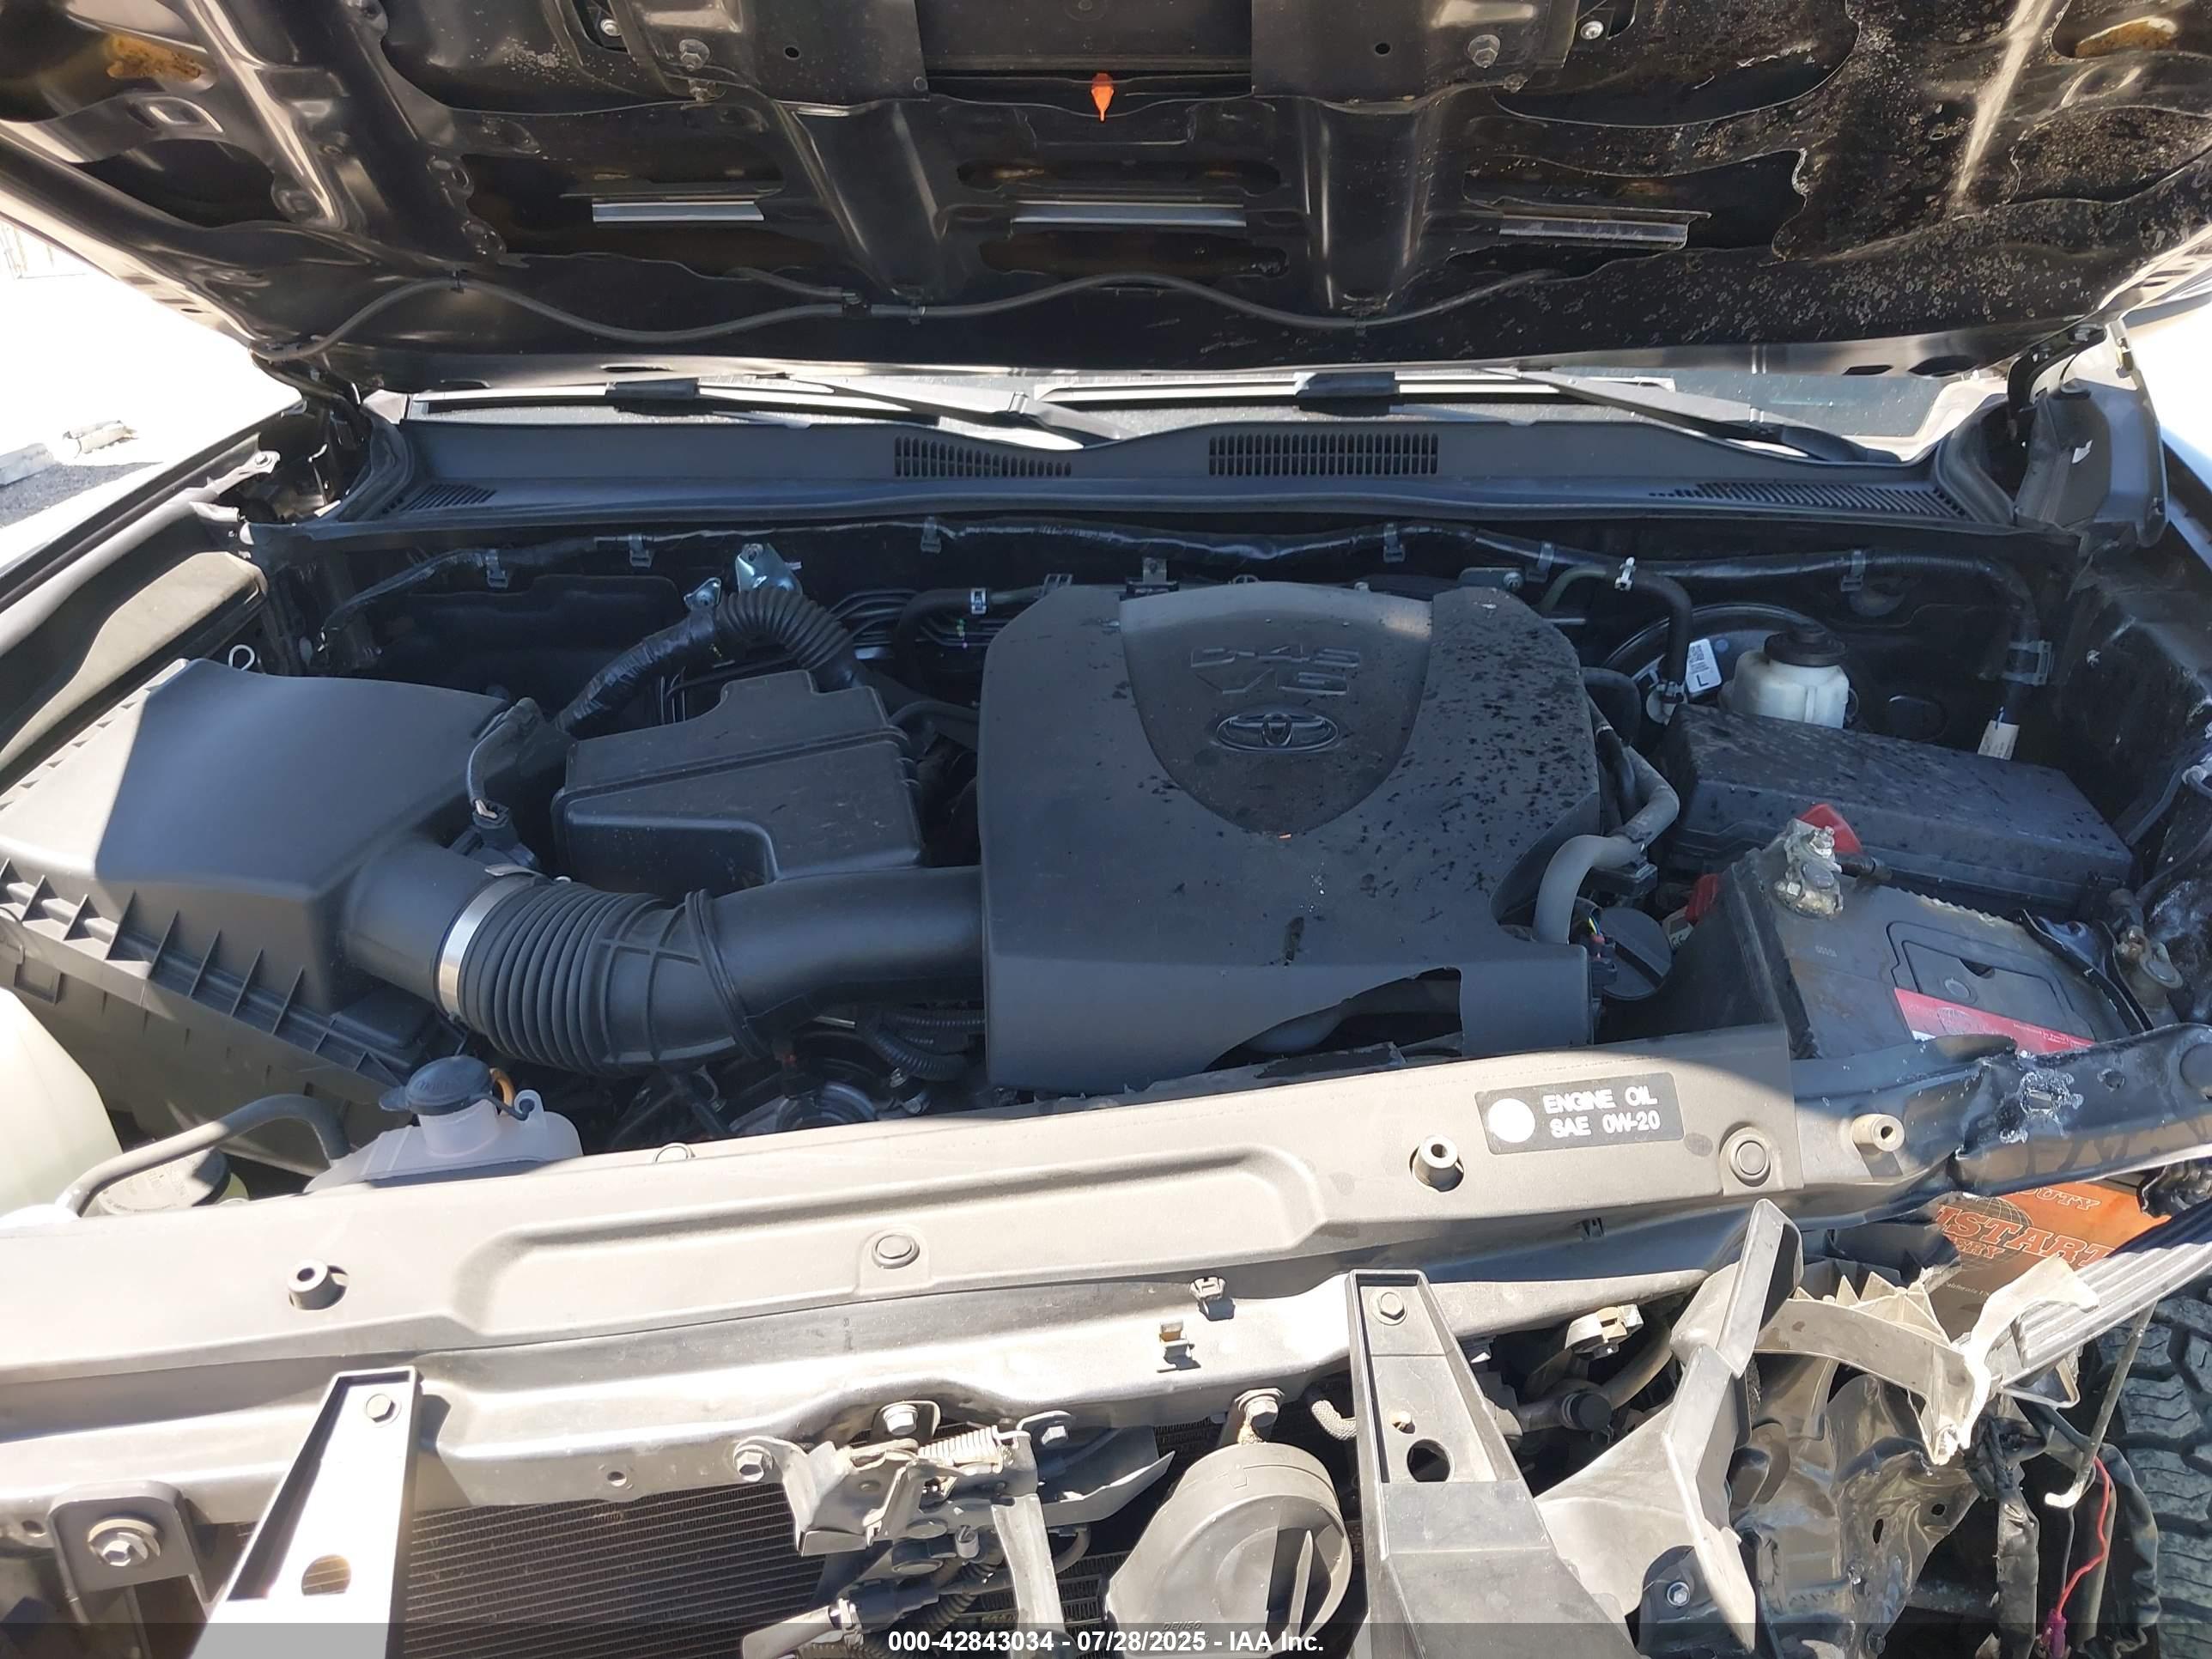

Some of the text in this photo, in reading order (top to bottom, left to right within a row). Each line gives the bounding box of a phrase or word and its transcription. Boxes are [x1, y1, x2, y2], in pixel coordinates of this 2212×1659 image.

[1696, 673, 1710, 687] L
[1542, 1085, 1658, 1115] ENGINE OIL
[1549, 1109, 1662, 1139] SAE 0W-20
[1162, 1620, 1203, 1632] DENSO
